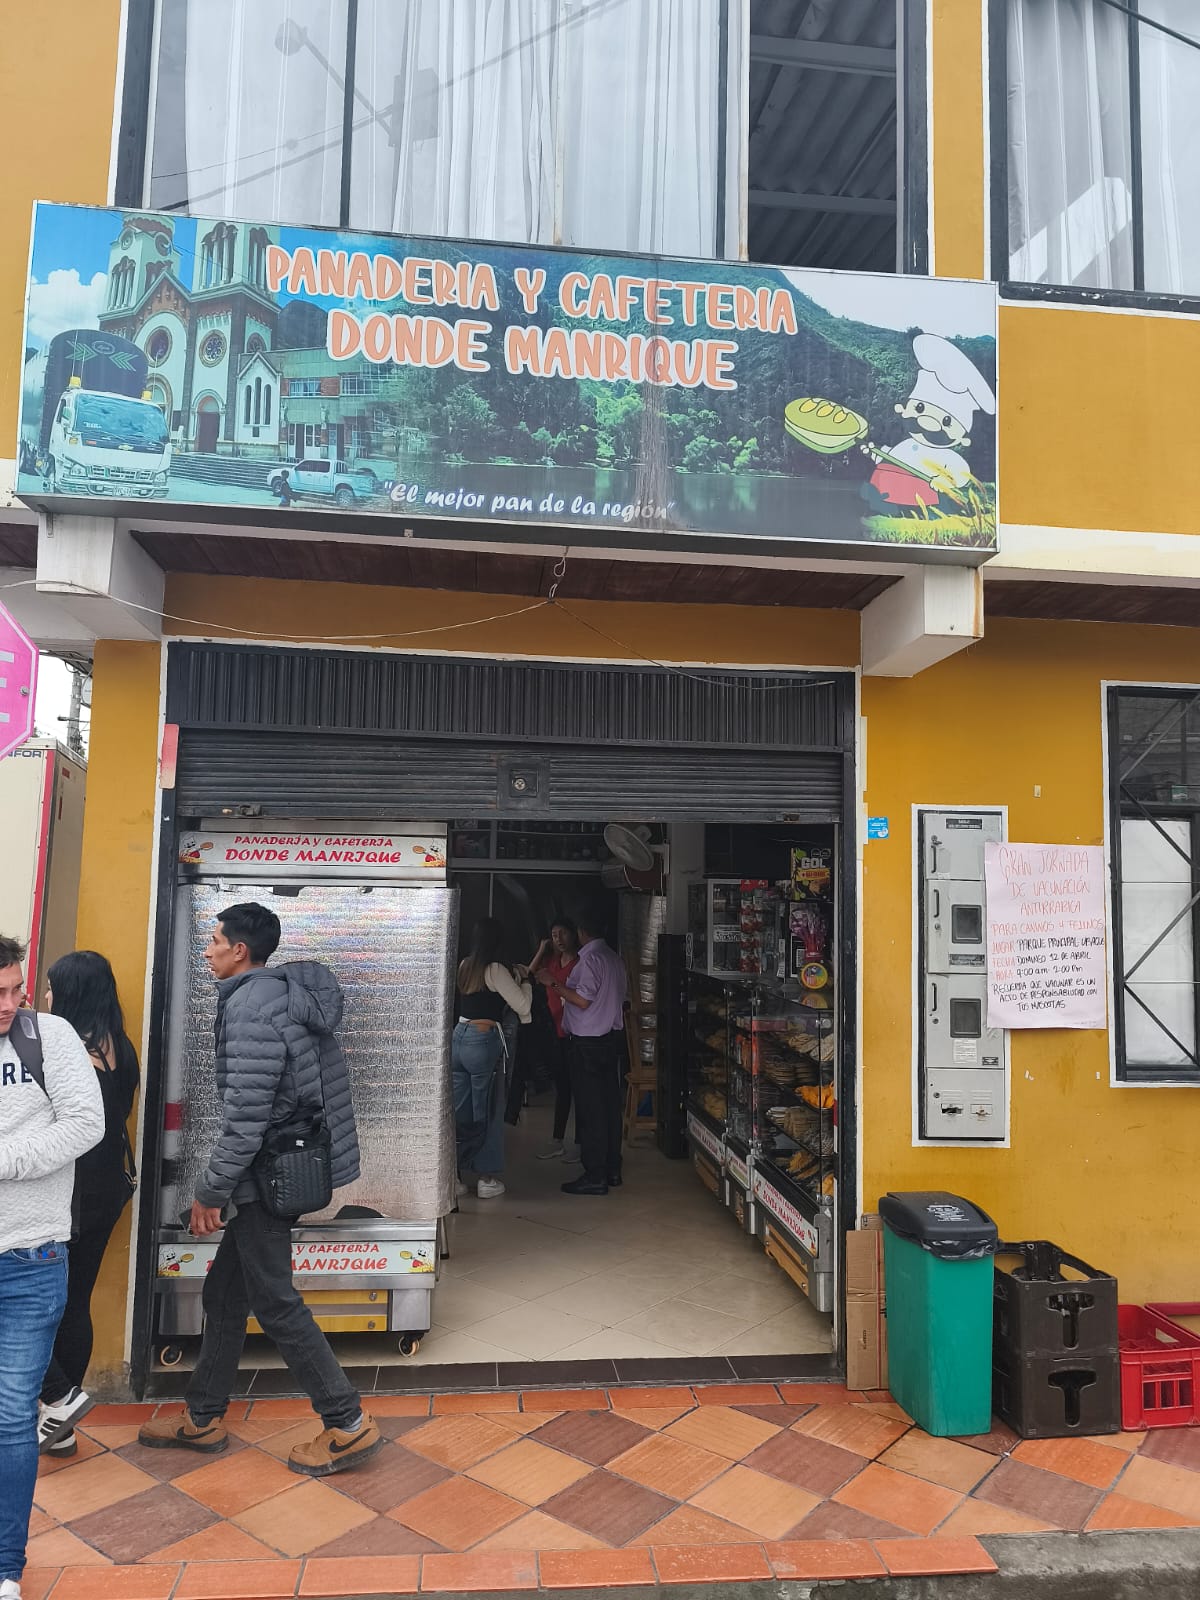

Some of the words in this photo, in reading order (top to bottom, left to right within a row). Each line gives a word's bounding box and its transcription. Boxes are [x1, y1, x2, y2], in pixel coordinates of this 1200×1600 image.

[266, 245, 500, 312] PANADERIA
[514, 267, 546, 315] Y
[558, 271, 798, 336] CAFETERIA
[327, 308, 492, 373] DONDE
[504, 325, 738, 391] MANRIQUE
[424, 487, 485, 510] mejor
[490, 494, 533, 512] pan
[539, 493, 565, 513] de
[570, 495, 596, 516] la
[225, 848, 289, 862] DONDE
[294, 850, 401, 863] MANRIQUE
[801, 857, 826, 868] GOL
[999, 847, 1031, 885] GRAN
[1038, 849, 1089, 874] JORNADA
[1010, 881, 1025, 898] DE
[991, 923, 1017, 936] PARA
[1016, 954, 1046, 966] DOMINGO
[1016, 968, 1034, 978] 9:00
[1030, 980, 1042, 989] QUE
[1020, 992, 1028, 1000] DE
[296, 1243, 305, 1255] Y
